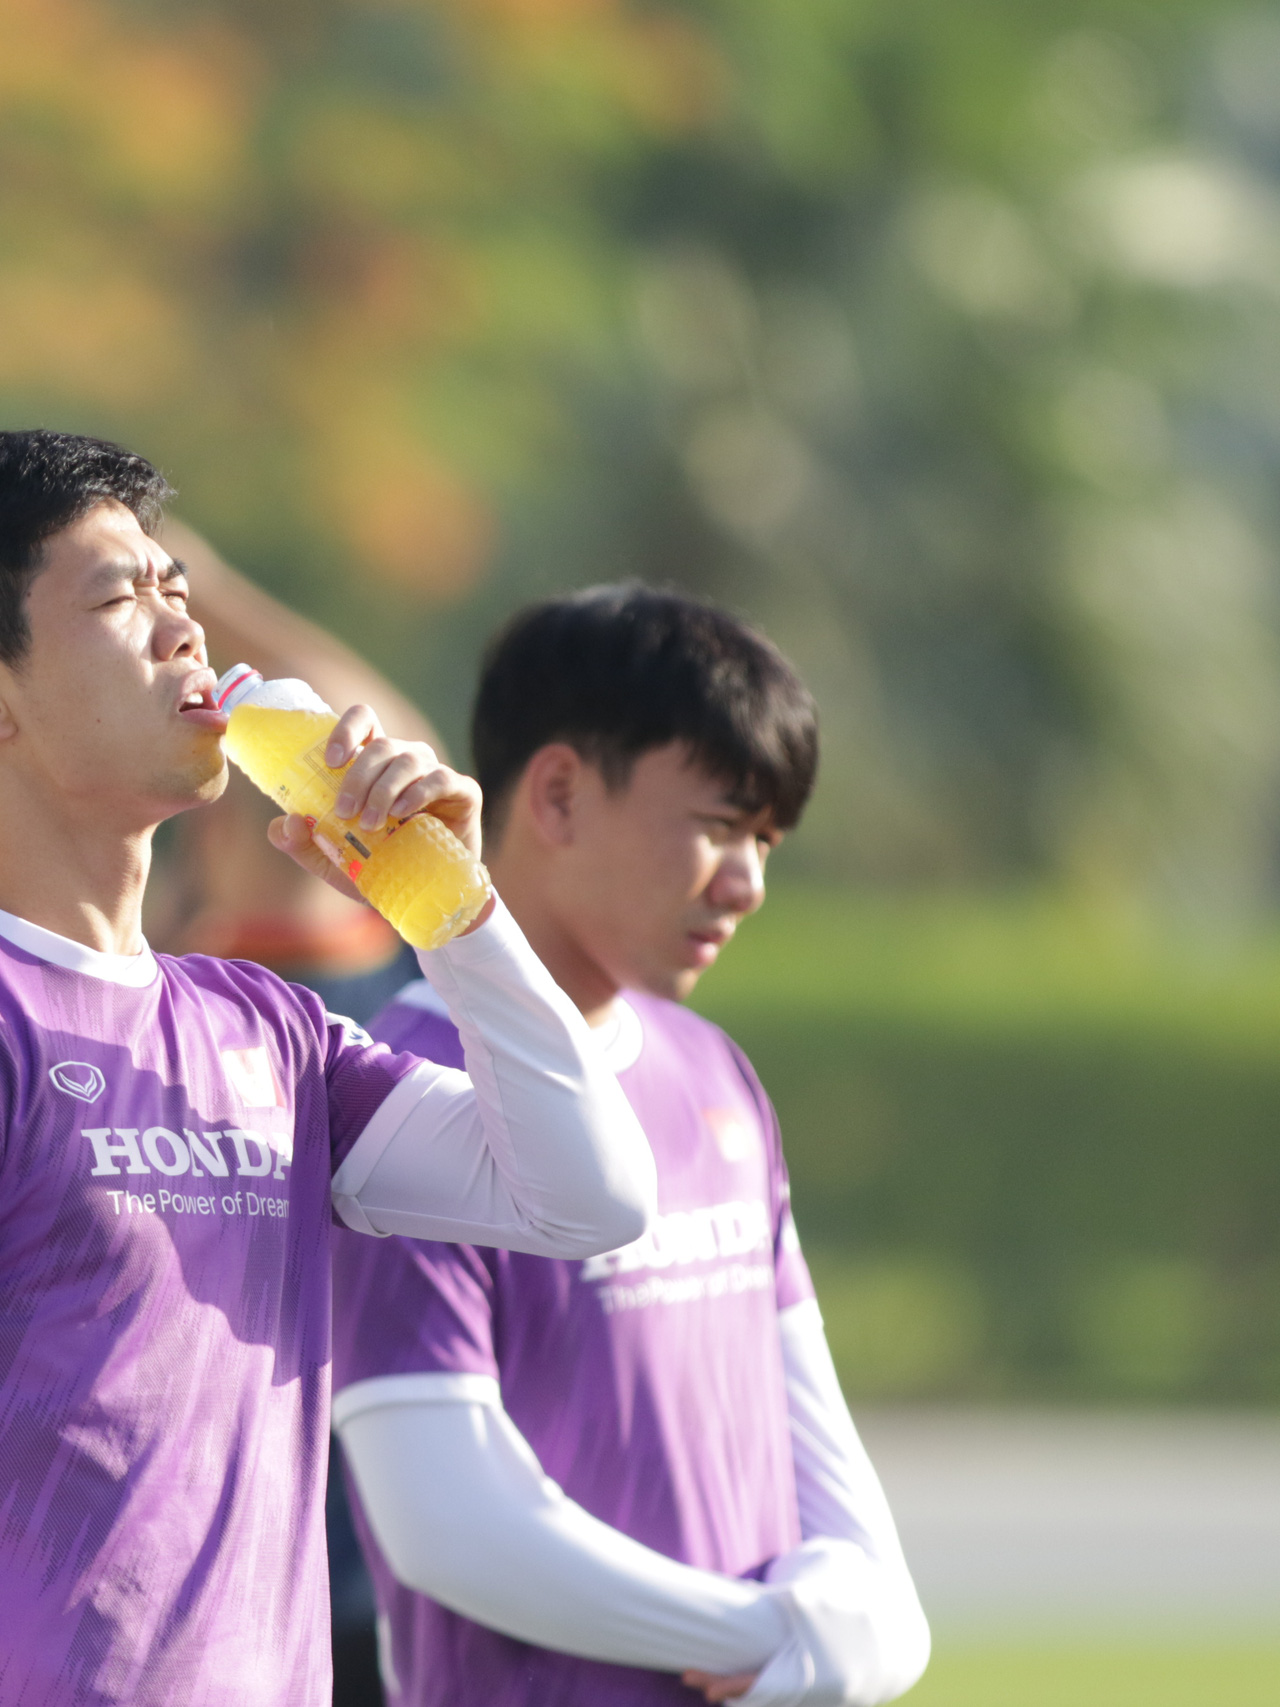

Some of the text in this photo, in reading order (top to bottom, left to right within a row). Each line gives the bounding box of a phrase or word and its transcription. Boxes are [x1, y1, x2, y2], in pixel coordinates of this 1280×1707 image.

[106, 1190, 156, 1215] The
[158, 1189, 216, 1215] Power
[221, 1191, 242, 1215] of
